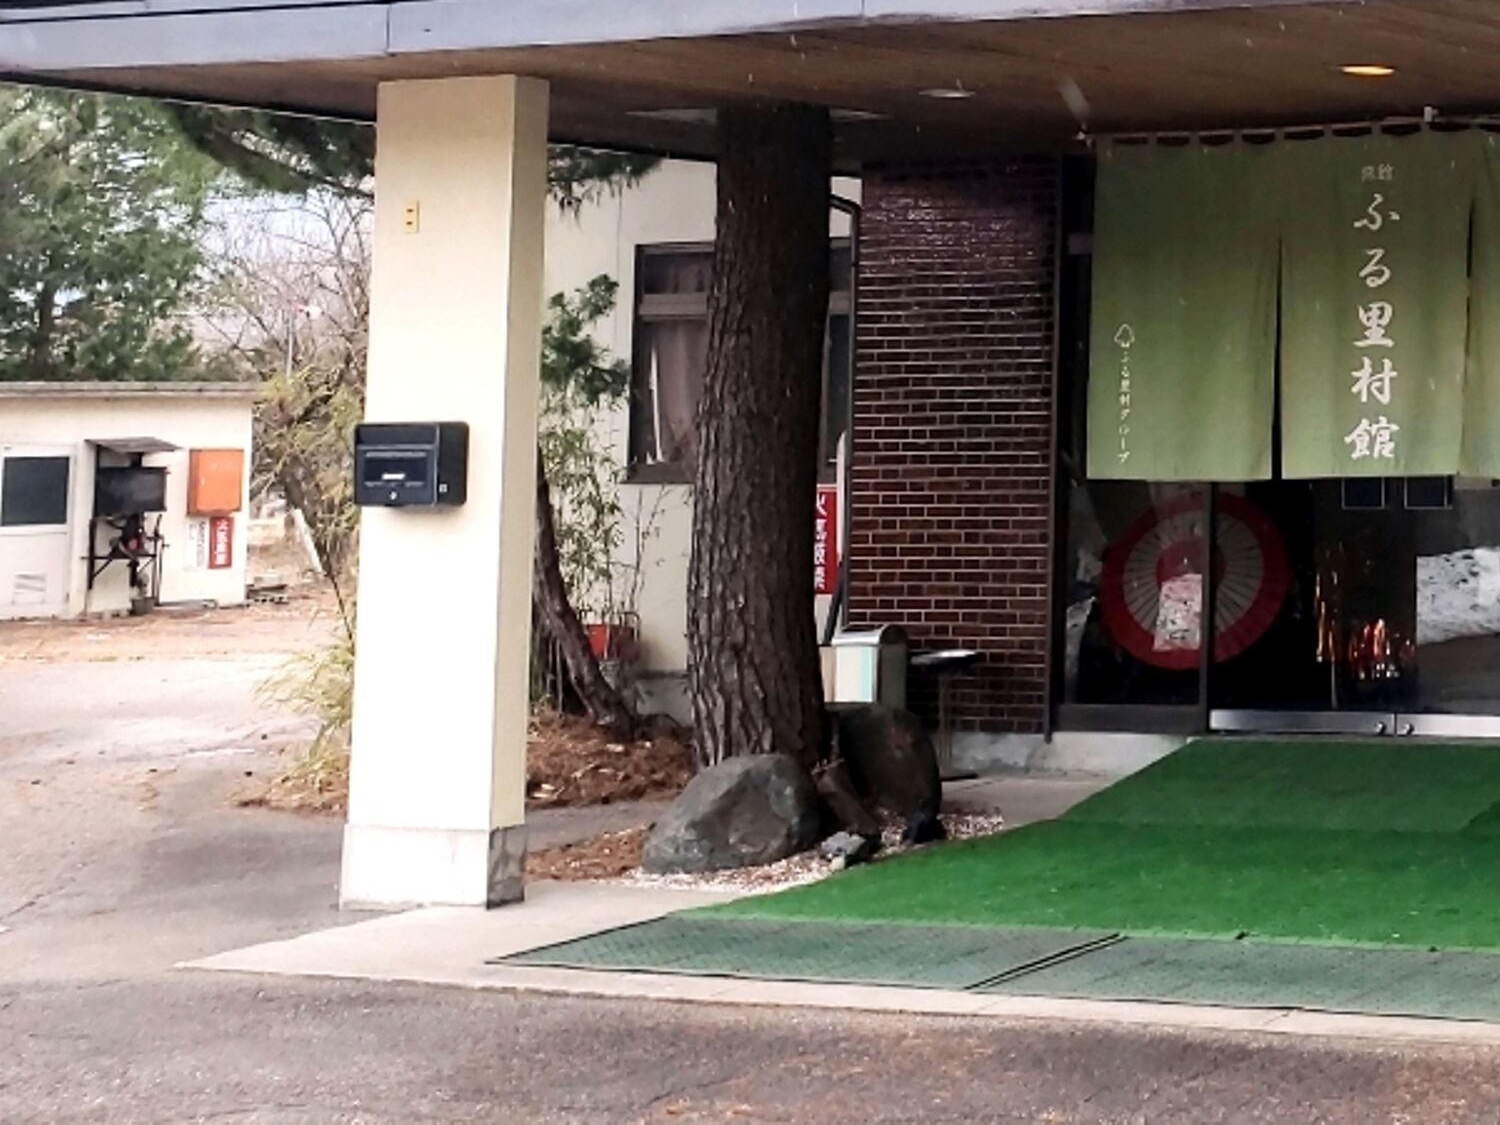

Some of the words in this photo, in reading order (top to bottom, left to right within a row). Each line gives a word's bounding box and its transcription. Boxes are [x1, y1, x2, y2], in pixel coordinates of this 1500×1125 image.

[1344, 193, 1400, 460] ふる里村館
